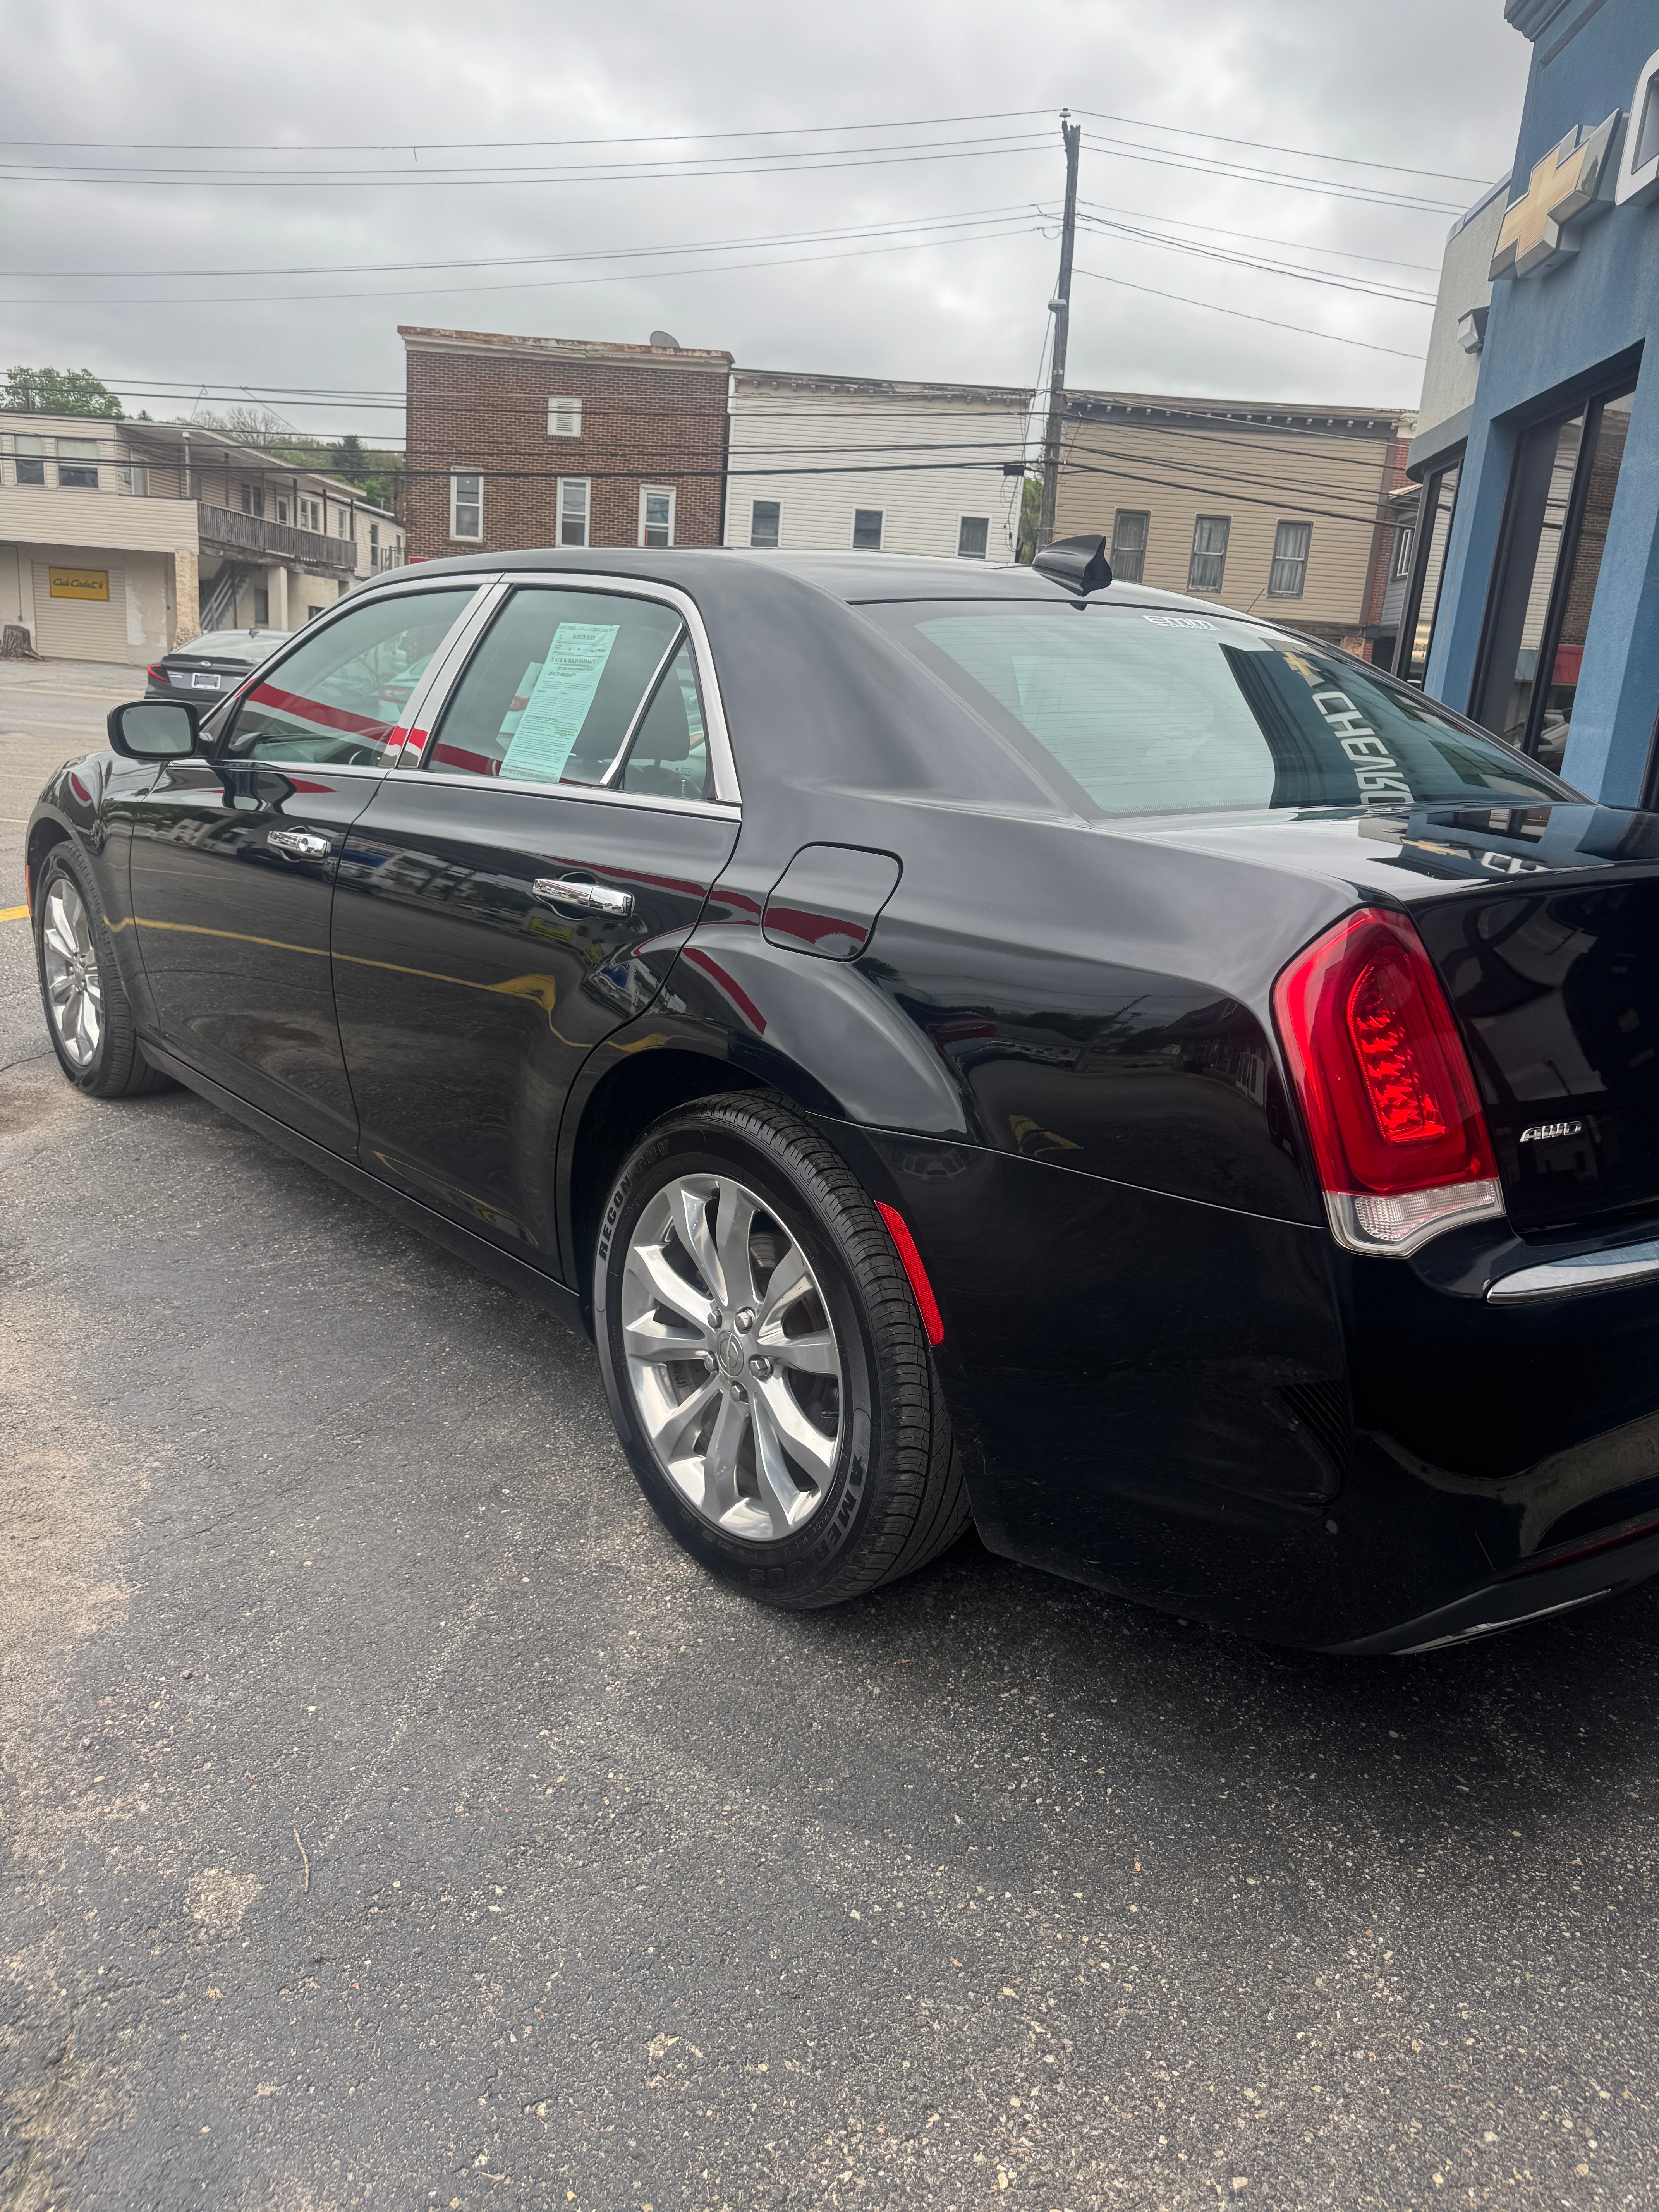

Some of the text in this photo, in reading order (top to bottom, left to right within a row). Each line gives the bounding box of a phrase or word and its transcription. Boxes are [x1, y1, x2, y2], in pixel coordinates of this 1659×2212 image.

[53, 578, 98, 589] Cub Cadet
[1519, 1121, 1582, 1142] AWD
[599, 1171, 632, 1261] RECON
[634, 1139, 669, 1174] CUV
